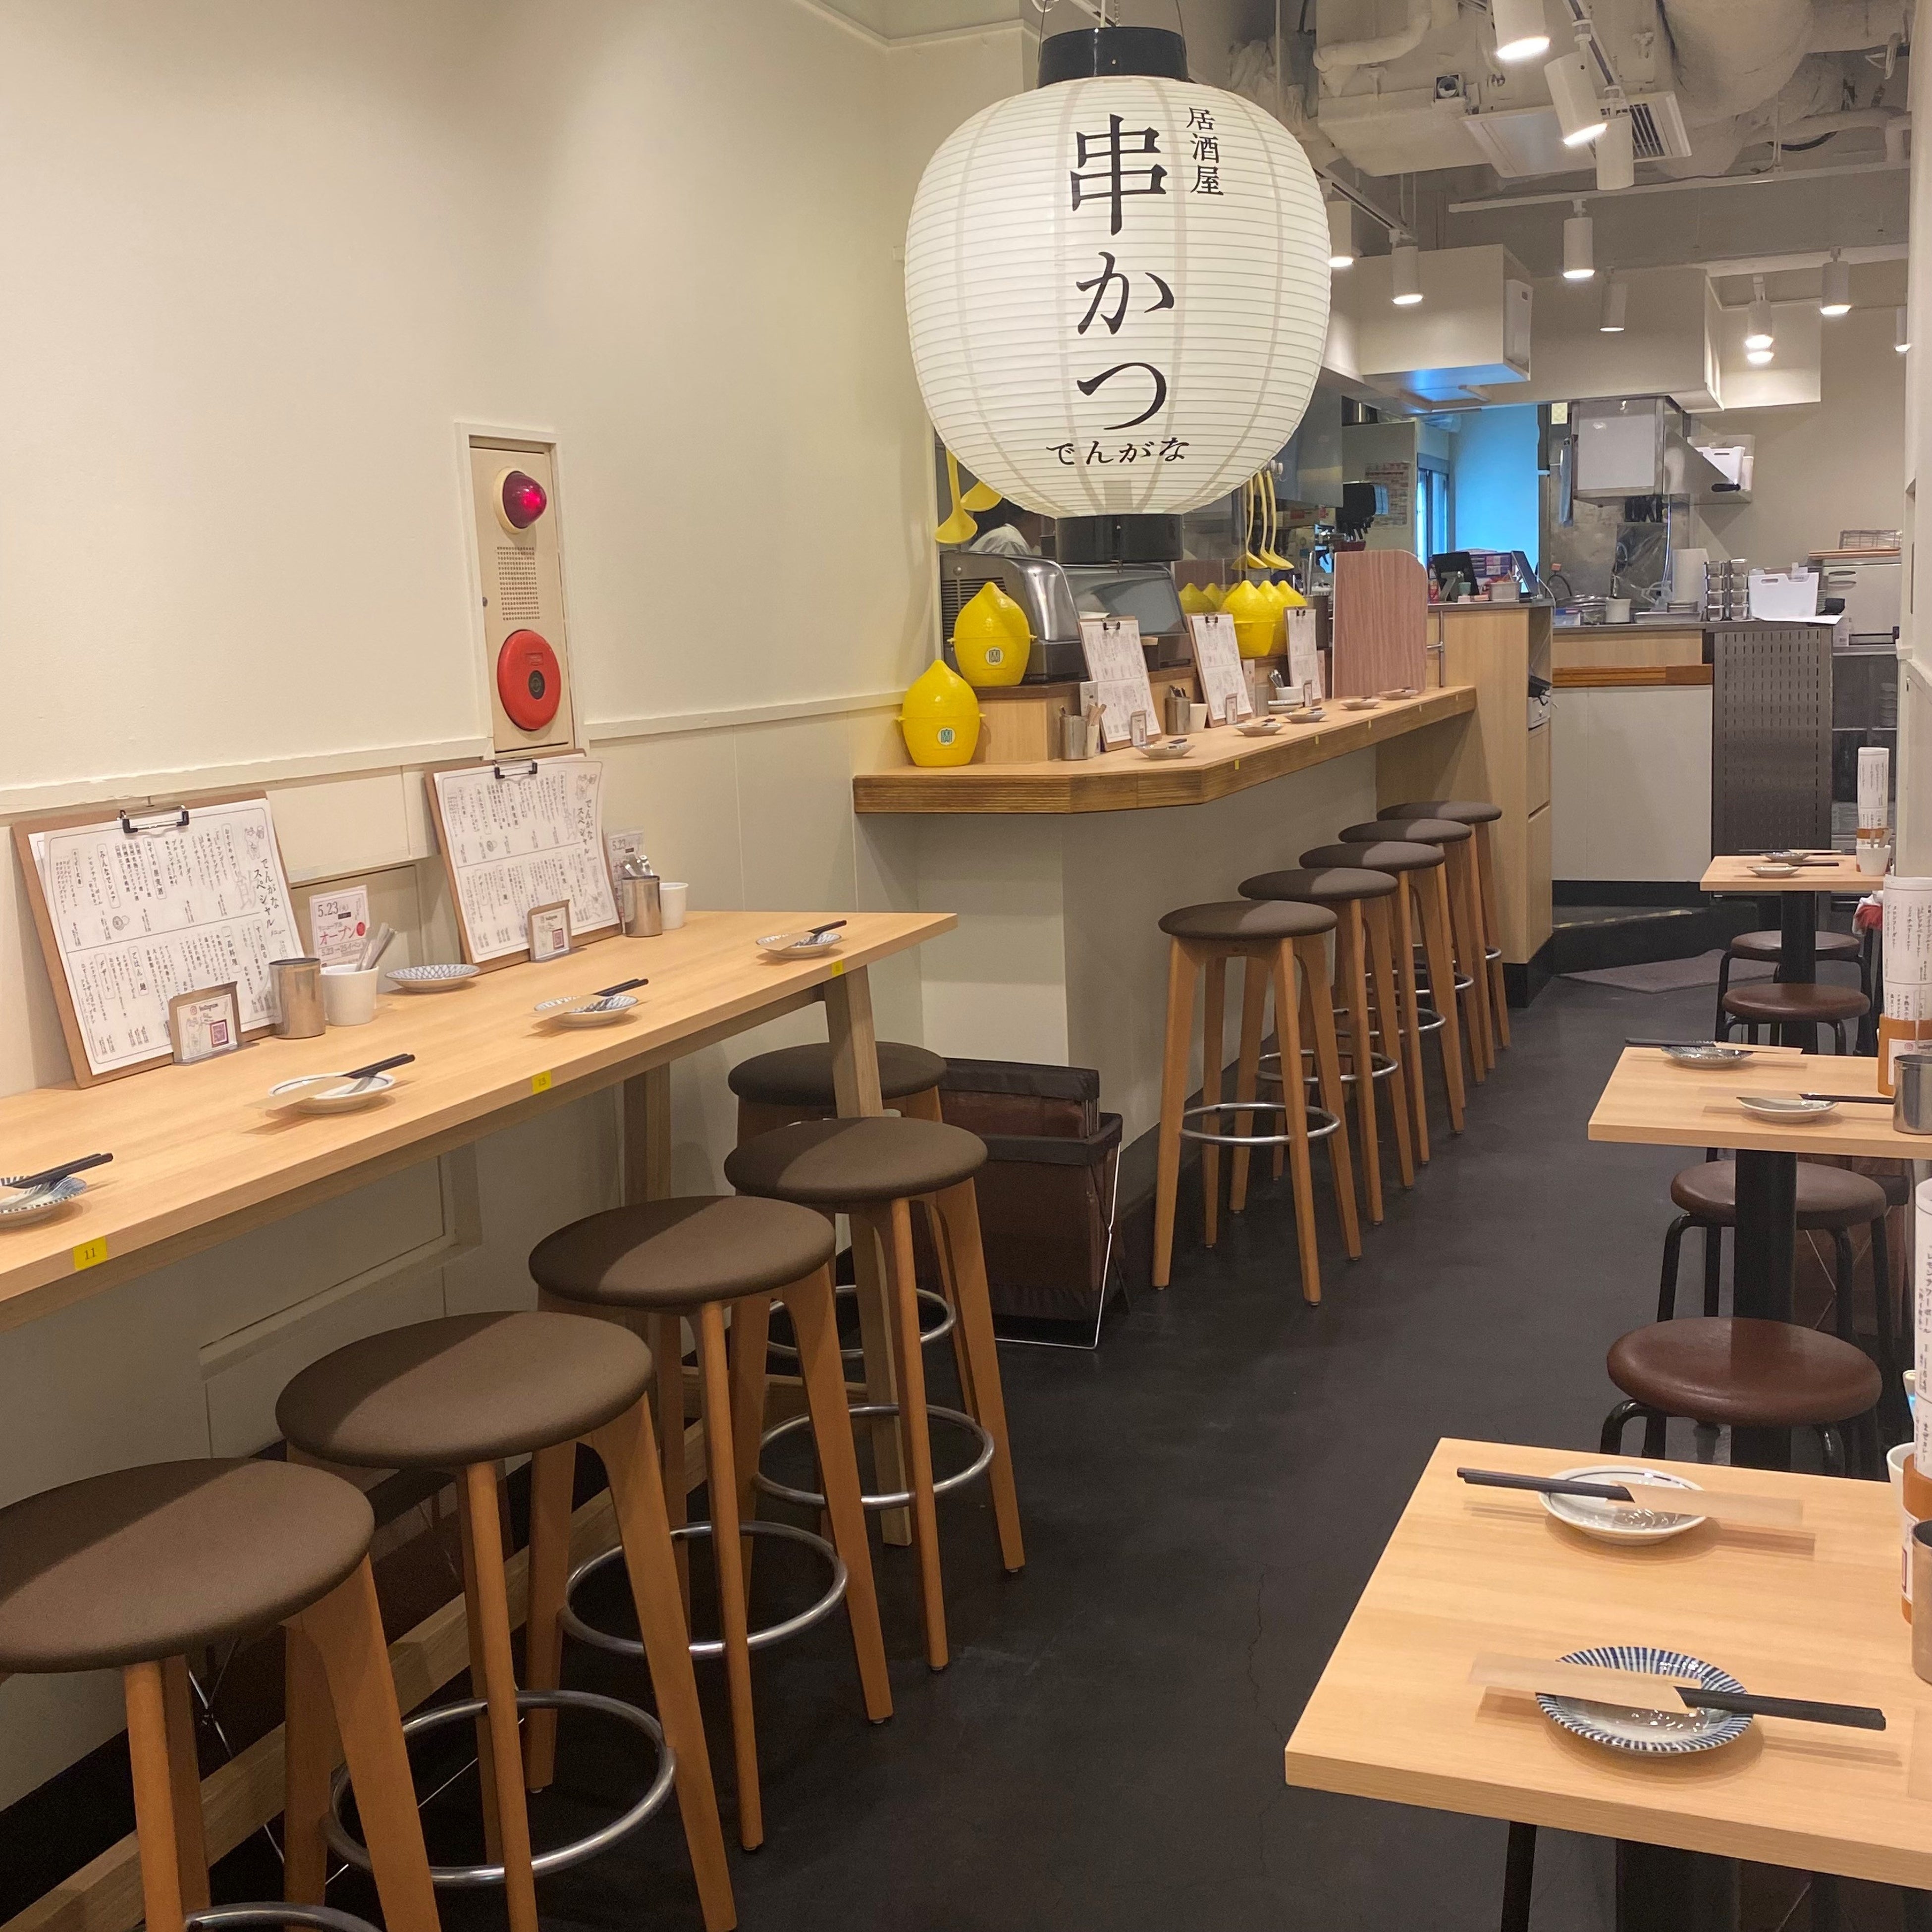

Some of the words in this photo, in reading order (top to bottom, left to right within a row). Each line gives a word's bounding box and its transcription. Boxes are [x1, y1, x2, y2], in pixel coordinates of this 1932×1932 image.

[1186, 107, 1224, 196] 居酒屋
[1070, 113, 1175, 430] 串かつ
[1046, 437, 1190, 465] でんがな
[254, 869, 275, 929] スペシャル
[261, 858, 280, 909] でんがな
[318, 901, 339, 918] 5.23
[319, 925, 356, 946] オープン
[84, 1247, 96, 1261] 11
